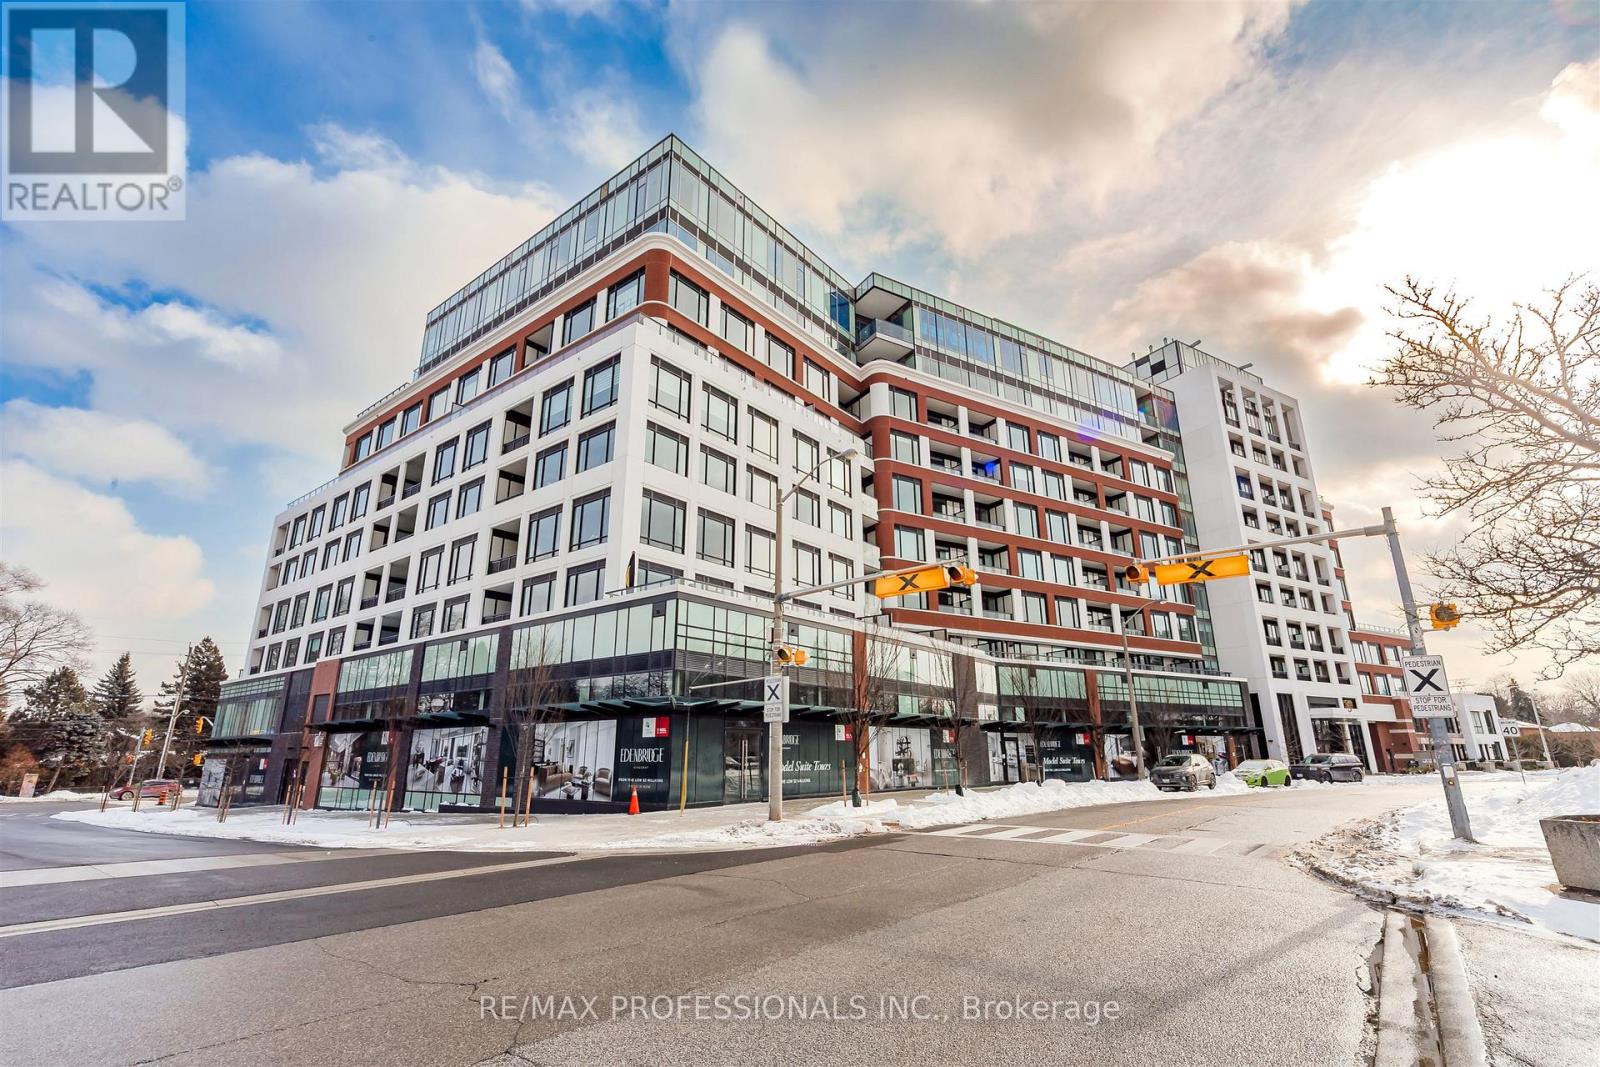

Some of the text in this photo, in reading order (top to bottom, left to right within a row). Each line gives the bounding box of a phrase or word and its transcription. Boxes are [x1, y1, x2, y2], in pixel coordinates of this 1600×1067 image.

[1404, 660, 1442, 668] PEDESTRIAN
[1415, 696, 1447, 704] STOP FOR
[1503, 726, 1518, 735] 40
[620, 747, 664, 763] EDENBRIDGE
[795, 760, 812, 772] Suite
[813, 760, 831, 771] Tours
